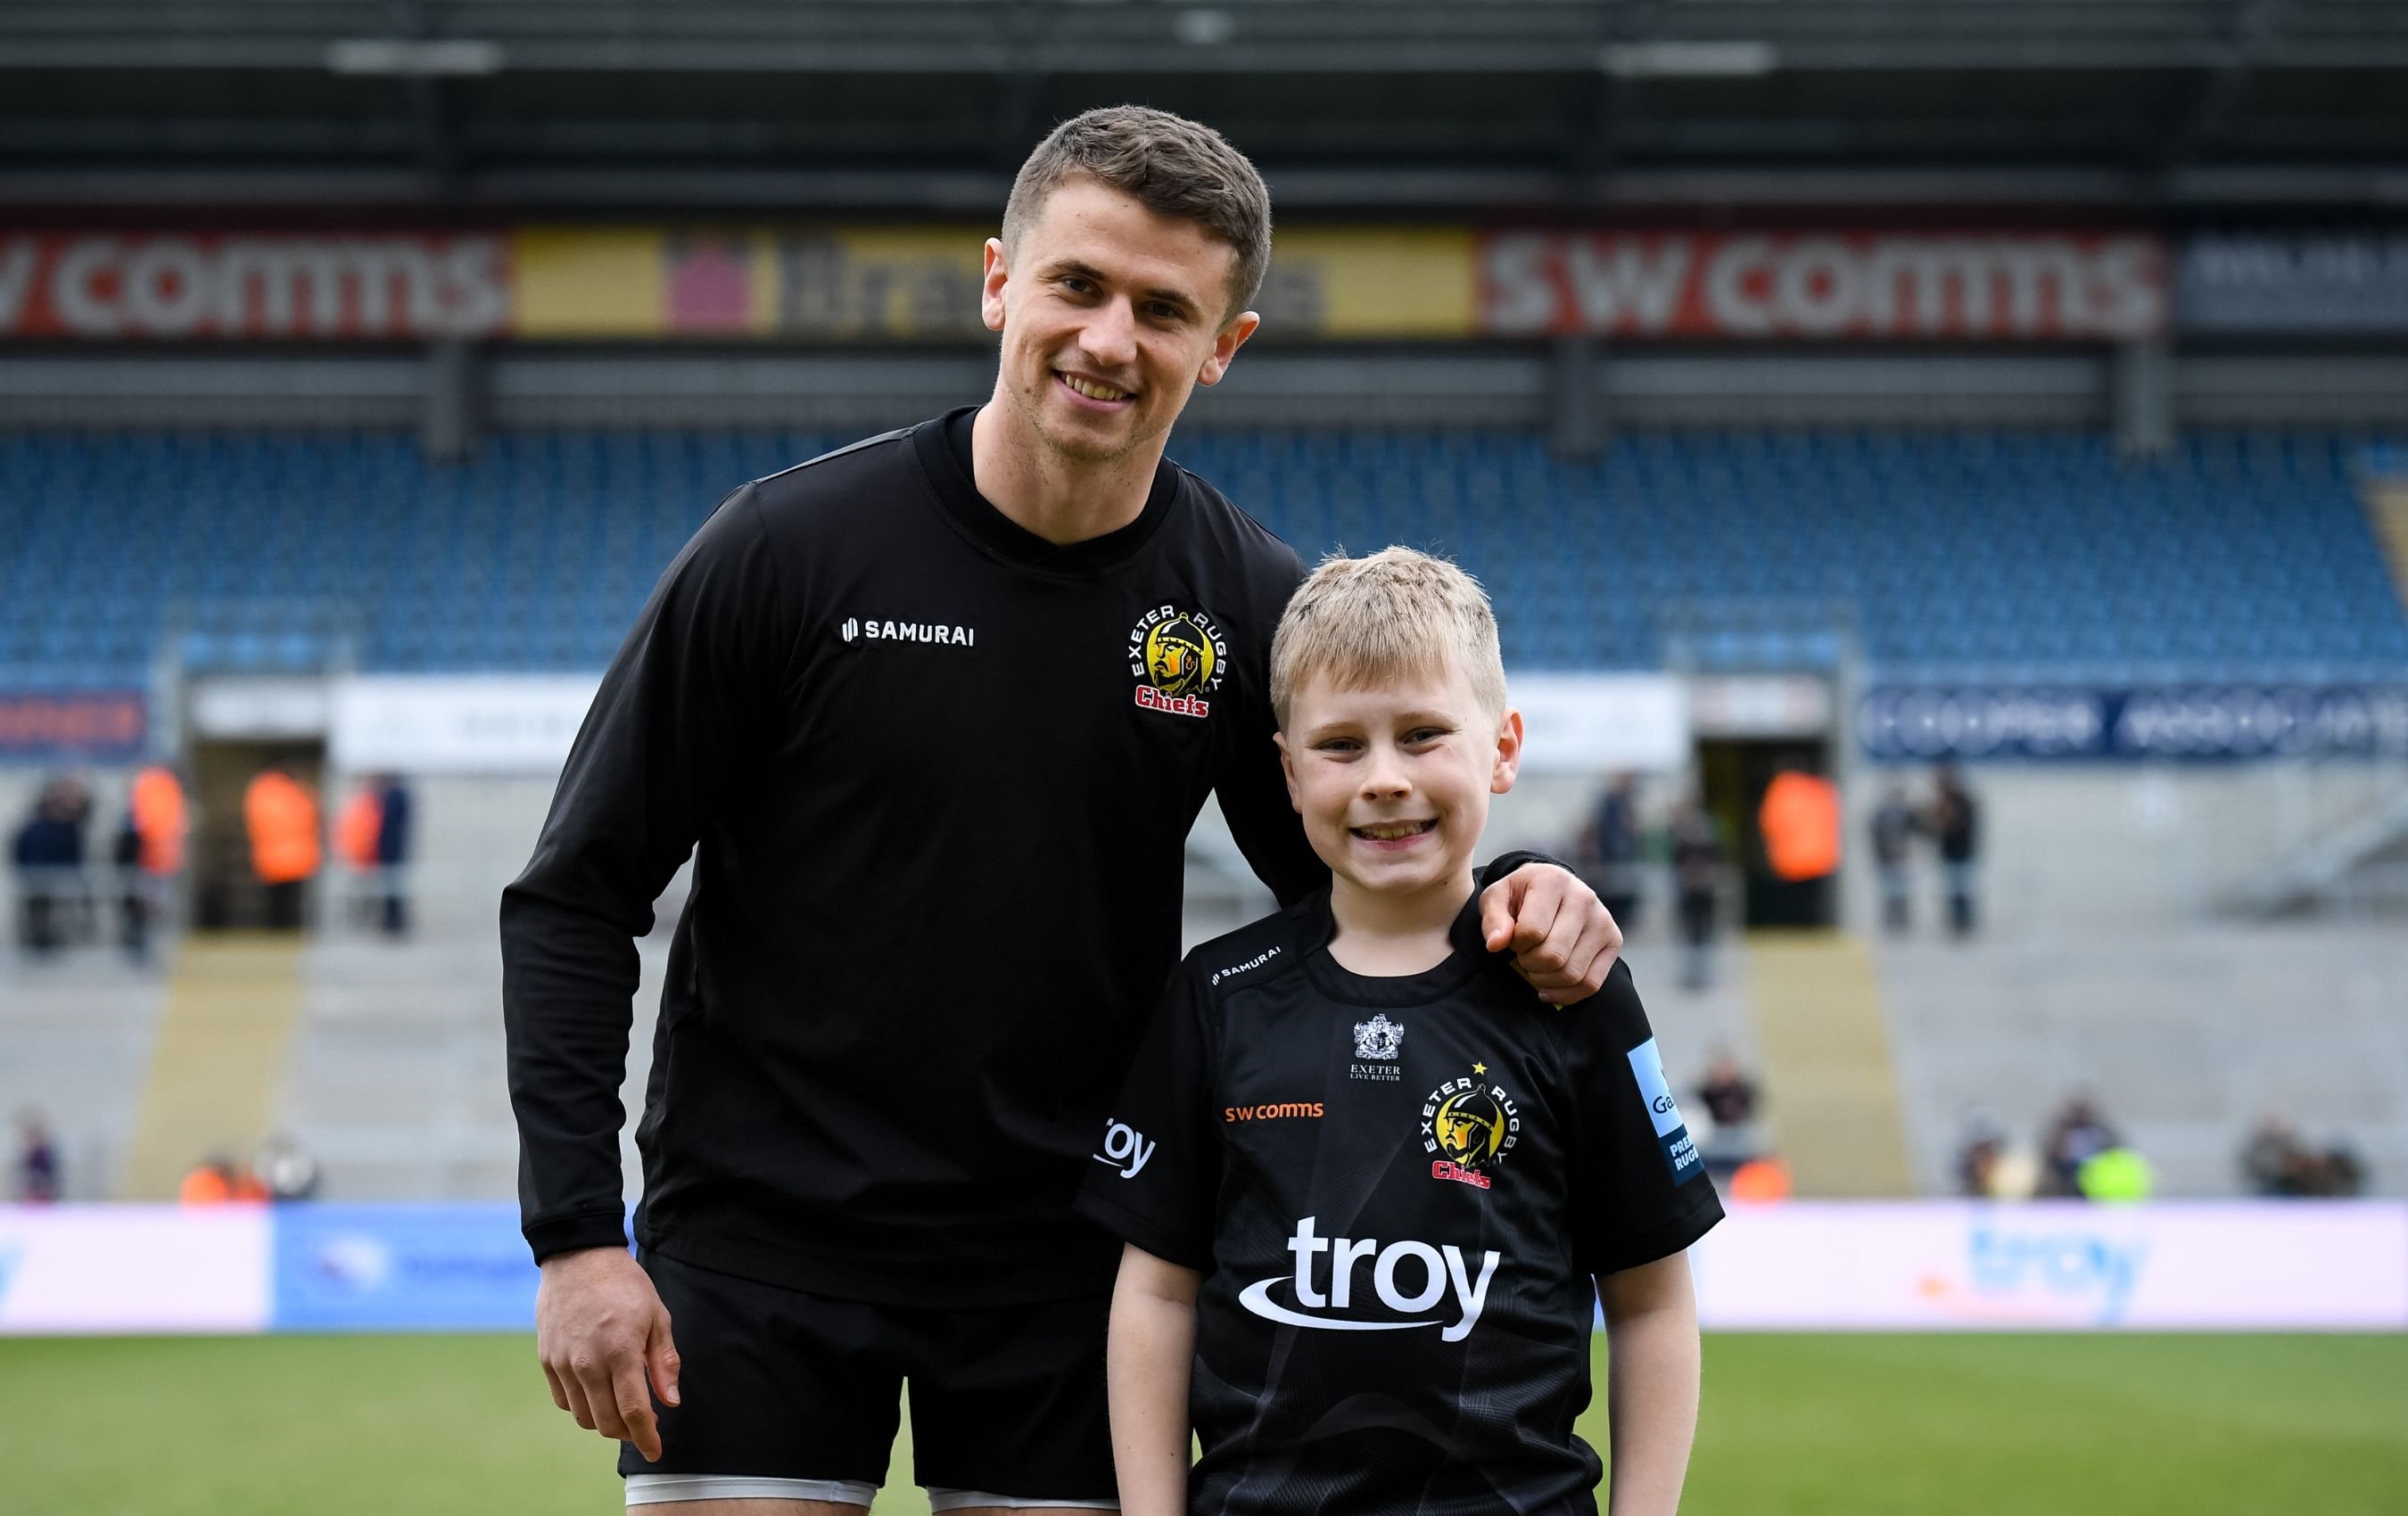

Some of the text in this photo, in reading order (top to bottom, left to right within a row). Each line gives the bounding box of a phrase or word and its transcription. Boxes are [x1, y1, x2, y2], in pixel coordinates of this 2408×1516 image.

[865, 621, 974, 647] SAMURAI
[1128, 605, 1226, 691] EXETER RUGBY
[1135, 684, 1209, 718] Chiefs
[1221, 946, 1281, 977] SAMURAI
[1350, 1064, 1400, 1075] EXETER
[1421, 1077, 1521, 1165] EXETER RUGBY
[1431, 1160, 1491, 1190] Chiefs
[1287, 1215, 1501, 1342] troy
